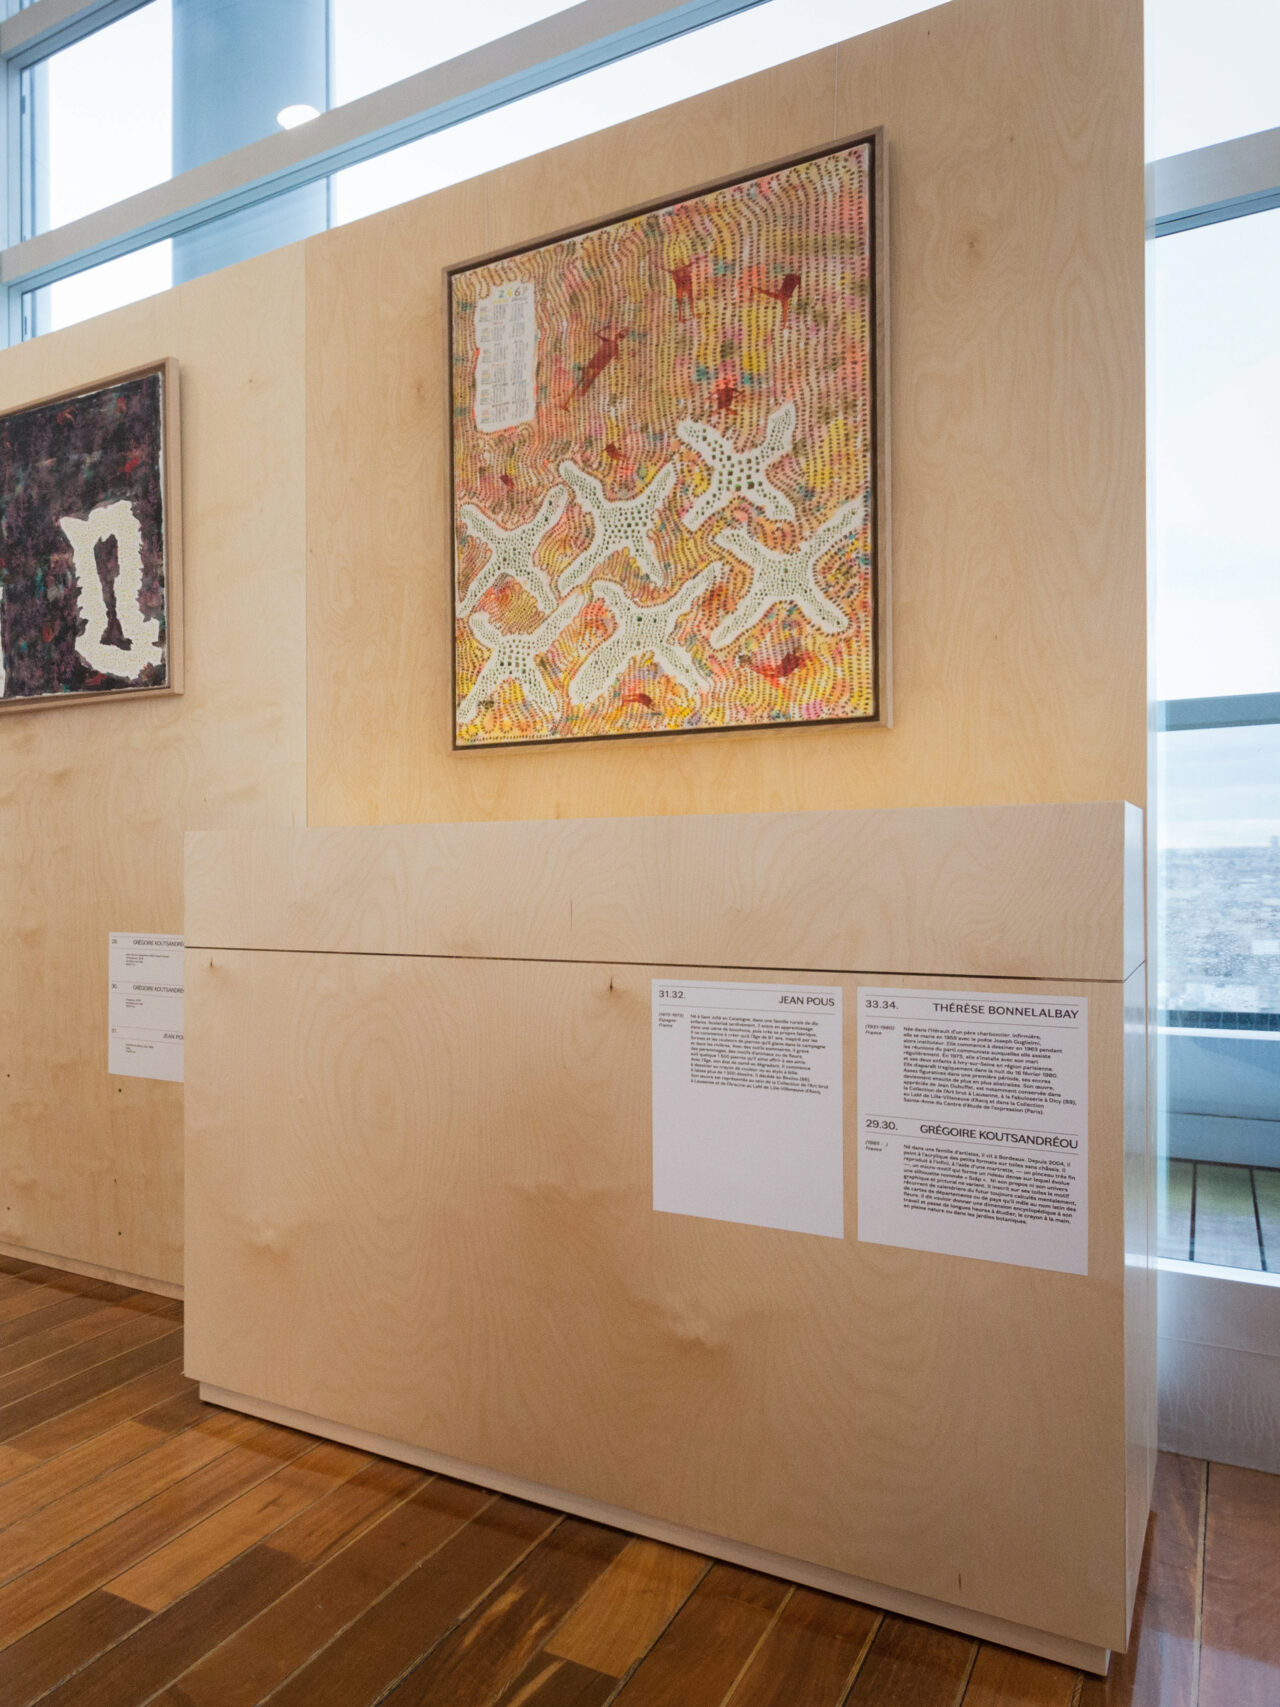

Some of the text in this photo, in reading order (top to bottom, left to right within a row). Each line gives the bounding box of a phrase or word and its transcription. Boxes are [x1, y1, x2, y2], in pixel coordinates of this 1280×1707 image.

[658, 989, 835, 1007] 31.32. JEAN POUS
[865, 1000, 1079, 1019] 33.34. THÉRÈSE BONNELALBAY
[865, 1119, 1078, 1149] 29.30. GRÉGOIRE KOUTSANDRÉOU
